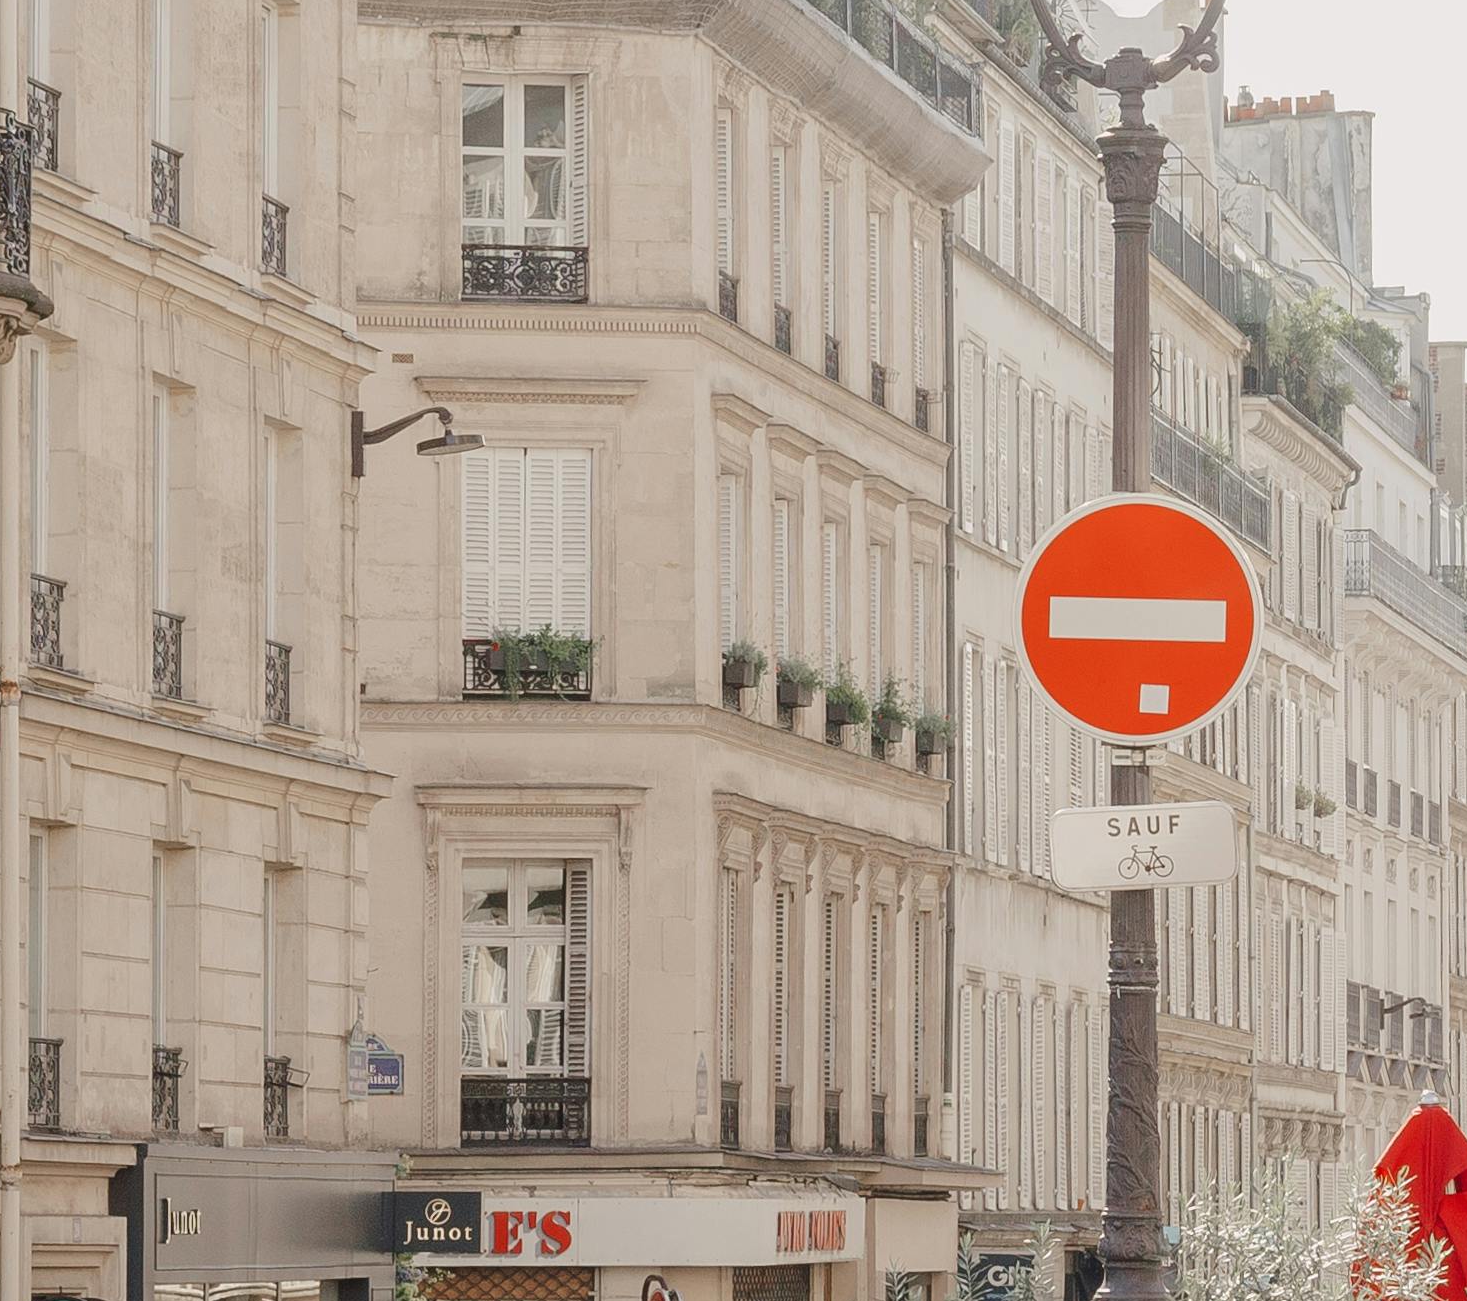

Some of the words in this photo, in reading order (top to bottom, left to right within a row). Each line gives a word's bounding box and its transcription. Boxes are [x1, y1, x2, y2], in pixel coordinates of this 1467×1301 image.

[1107, 814, 1182, 838] SAUF
[165, 1197, 202, 1245] Junot
[402, 1221, 474, 1245] Junot
